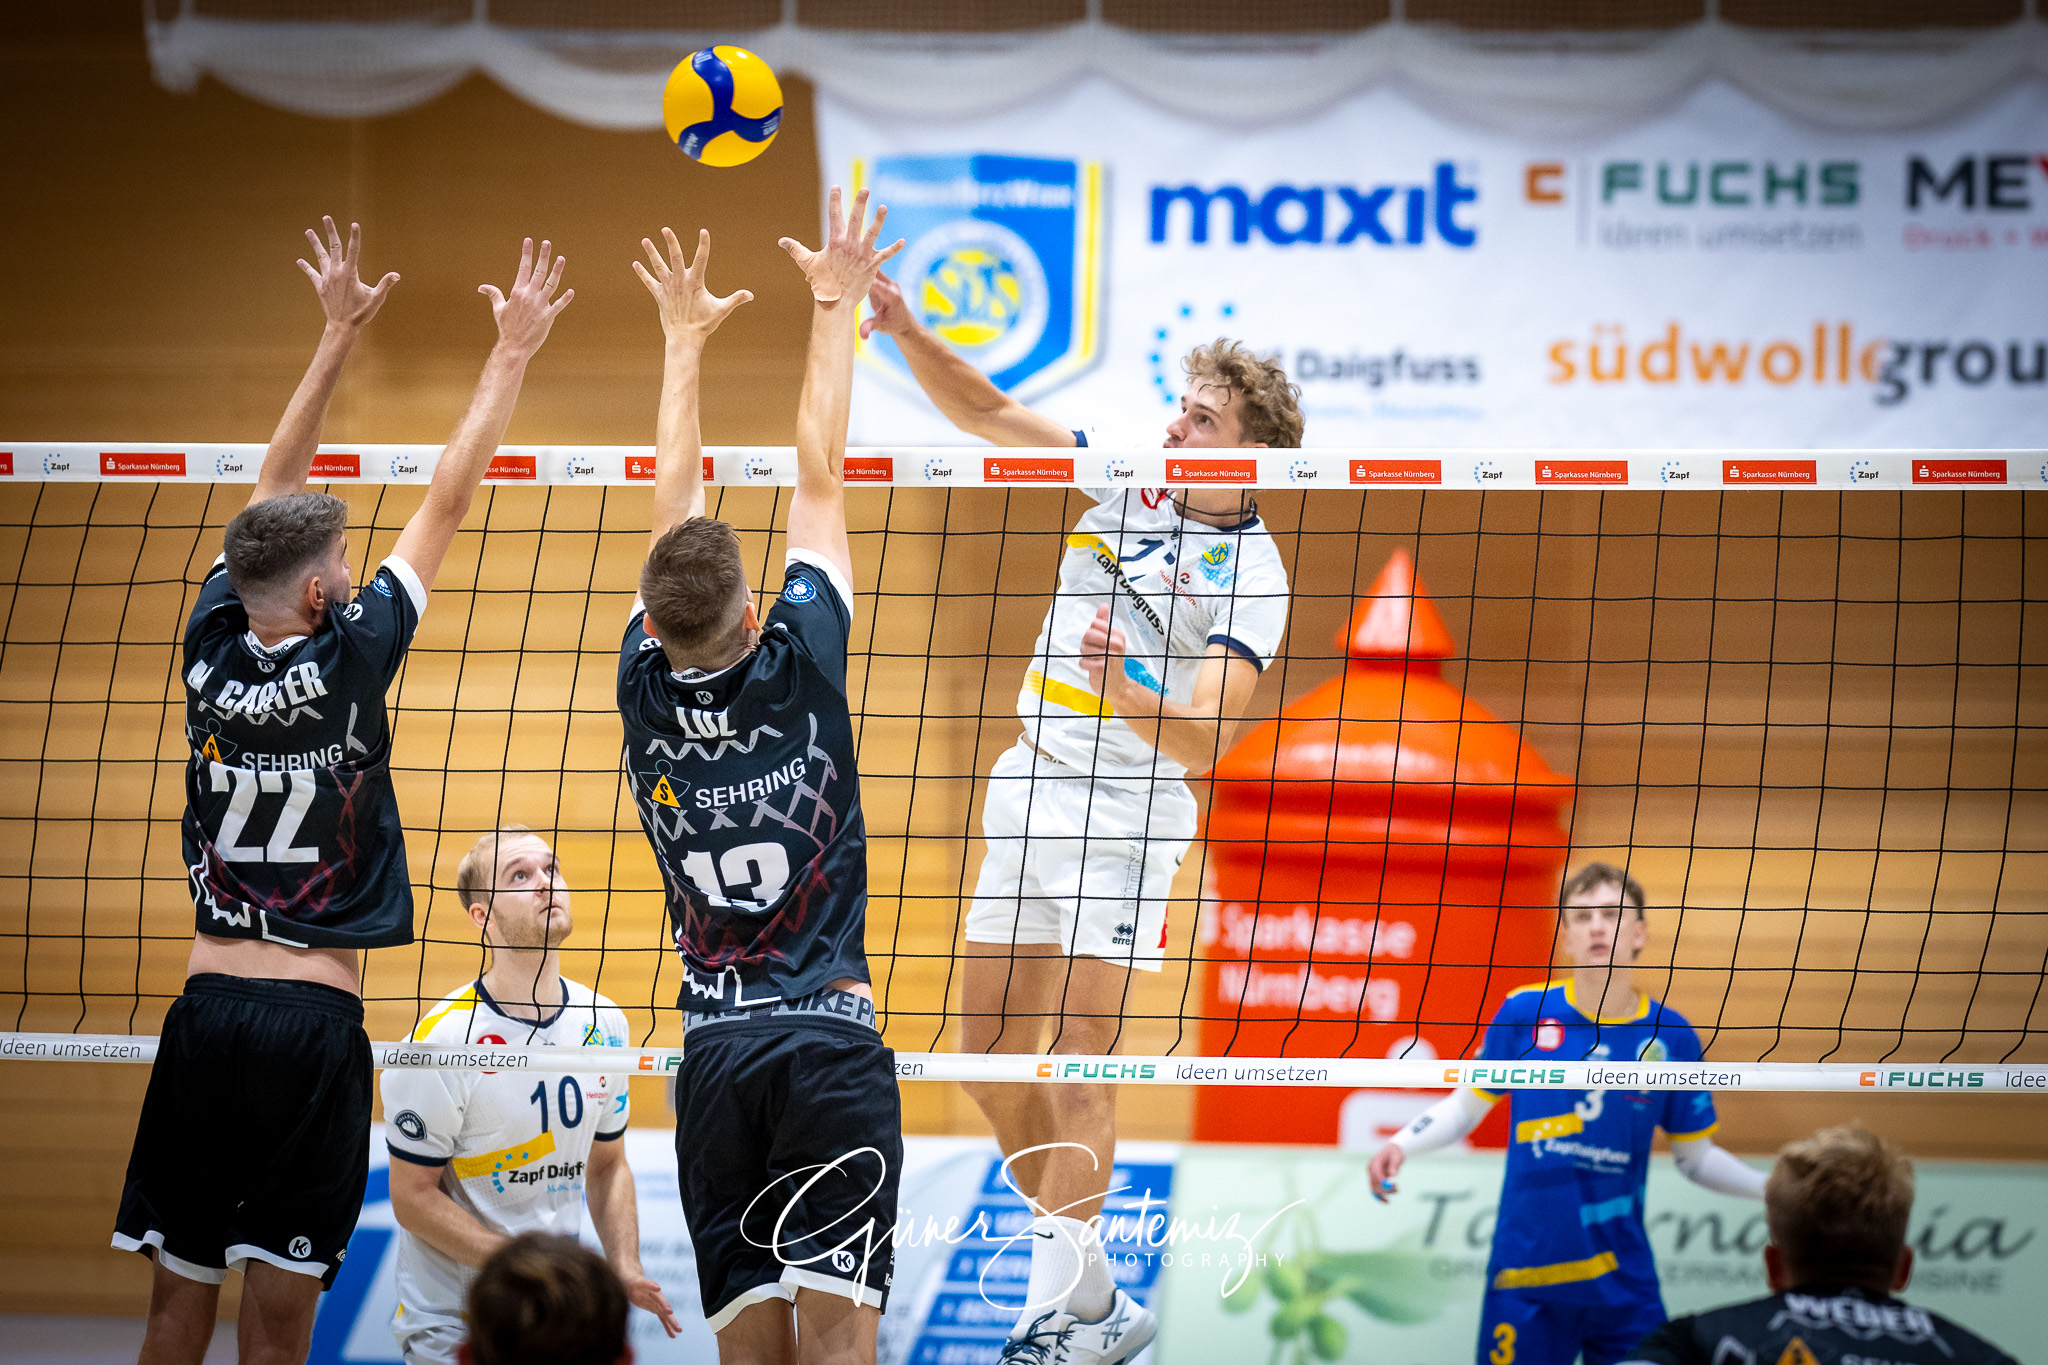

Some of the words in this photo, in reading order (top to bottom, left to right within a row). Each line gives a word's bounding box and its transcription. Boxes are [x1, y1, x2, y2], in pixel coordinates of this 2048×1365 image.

[1602, 162, 1862, 206] FUCHS
[1150, 161, 1479, 248] maxit
[51, 463, 70, 471] Zapf
[118, 463, 149, 471] Sparkasse
[150, 463, 180, 471] Nürnberg
[223, 464, 243, 472] Zapf
[398, 465, 418, 474] Zapf
[500, 466, 530, 474] Nürnberg
[575, 466, 594, 475] Zapf
[752, 467, 772, 476] Zapf
[856, 467, 887, 476] Nürnberg
[932, 468, 952, 477] Zapf
[1003, 468, 1036, 477] Sparkasse
[1037, 468, 1067, 477] Nürnberg
[1114, 469, 1134, 478] Zapf
[1184, 470, 1218, 478] Sparkasse
[1219, 469, 1250, 478] Nürnberg
[1297, 470, 1317, 479] Zapf
[1369, 470, 1402, 479] Sparkasse
[1404, 470, 1435, 479] Nürnberg
[1482, 470, 1503, 480] Zapf
[1554, 471, 1588, 479] Sparkasse
[1590, 470, 1621, 480] Nürnberg
[1669, 471, 1690, 480] Zapf
[1742, 470, 1777, 479] Sparkasse
[1778, 470, 1810, 479] Nürnberg
[1858, 470, 1879, 480] Zapf
[1932, 470, 1966, 479] Sparkasse
[1968, 470, 2000, 479] Nürnberg
[241, 744, 343, 771] SEHRING
[695, 757, 807, 809] SEHRING
[210, 761, 319, 863] 22
[681, 842, 790, 912] 13
[53, 1042, 140, 1058] umsetzen
[382, 1049, 432, 1066] Ideen
[438, 1051, 528, 1067] umsetzen
[1064, 1063, 1156, 1079] FUCHS
[1176, 1064, 1228, 1080] Ideen
[1234, 1065, 1328, 1082] umsetzen
[1471, 1069, 1566, 1084] FUCHS
[1586, 1067, 1639, 1085] Ideen
[1646, 1069, 1742, 1086] umsetzen
[1888, 1072, 1984, 1088] FUCHS
[530, 1075, 583, 1133] 10
[508, 1165, 545, 1186] Zapf
[1489, 1322, 1517, 1365] 3
